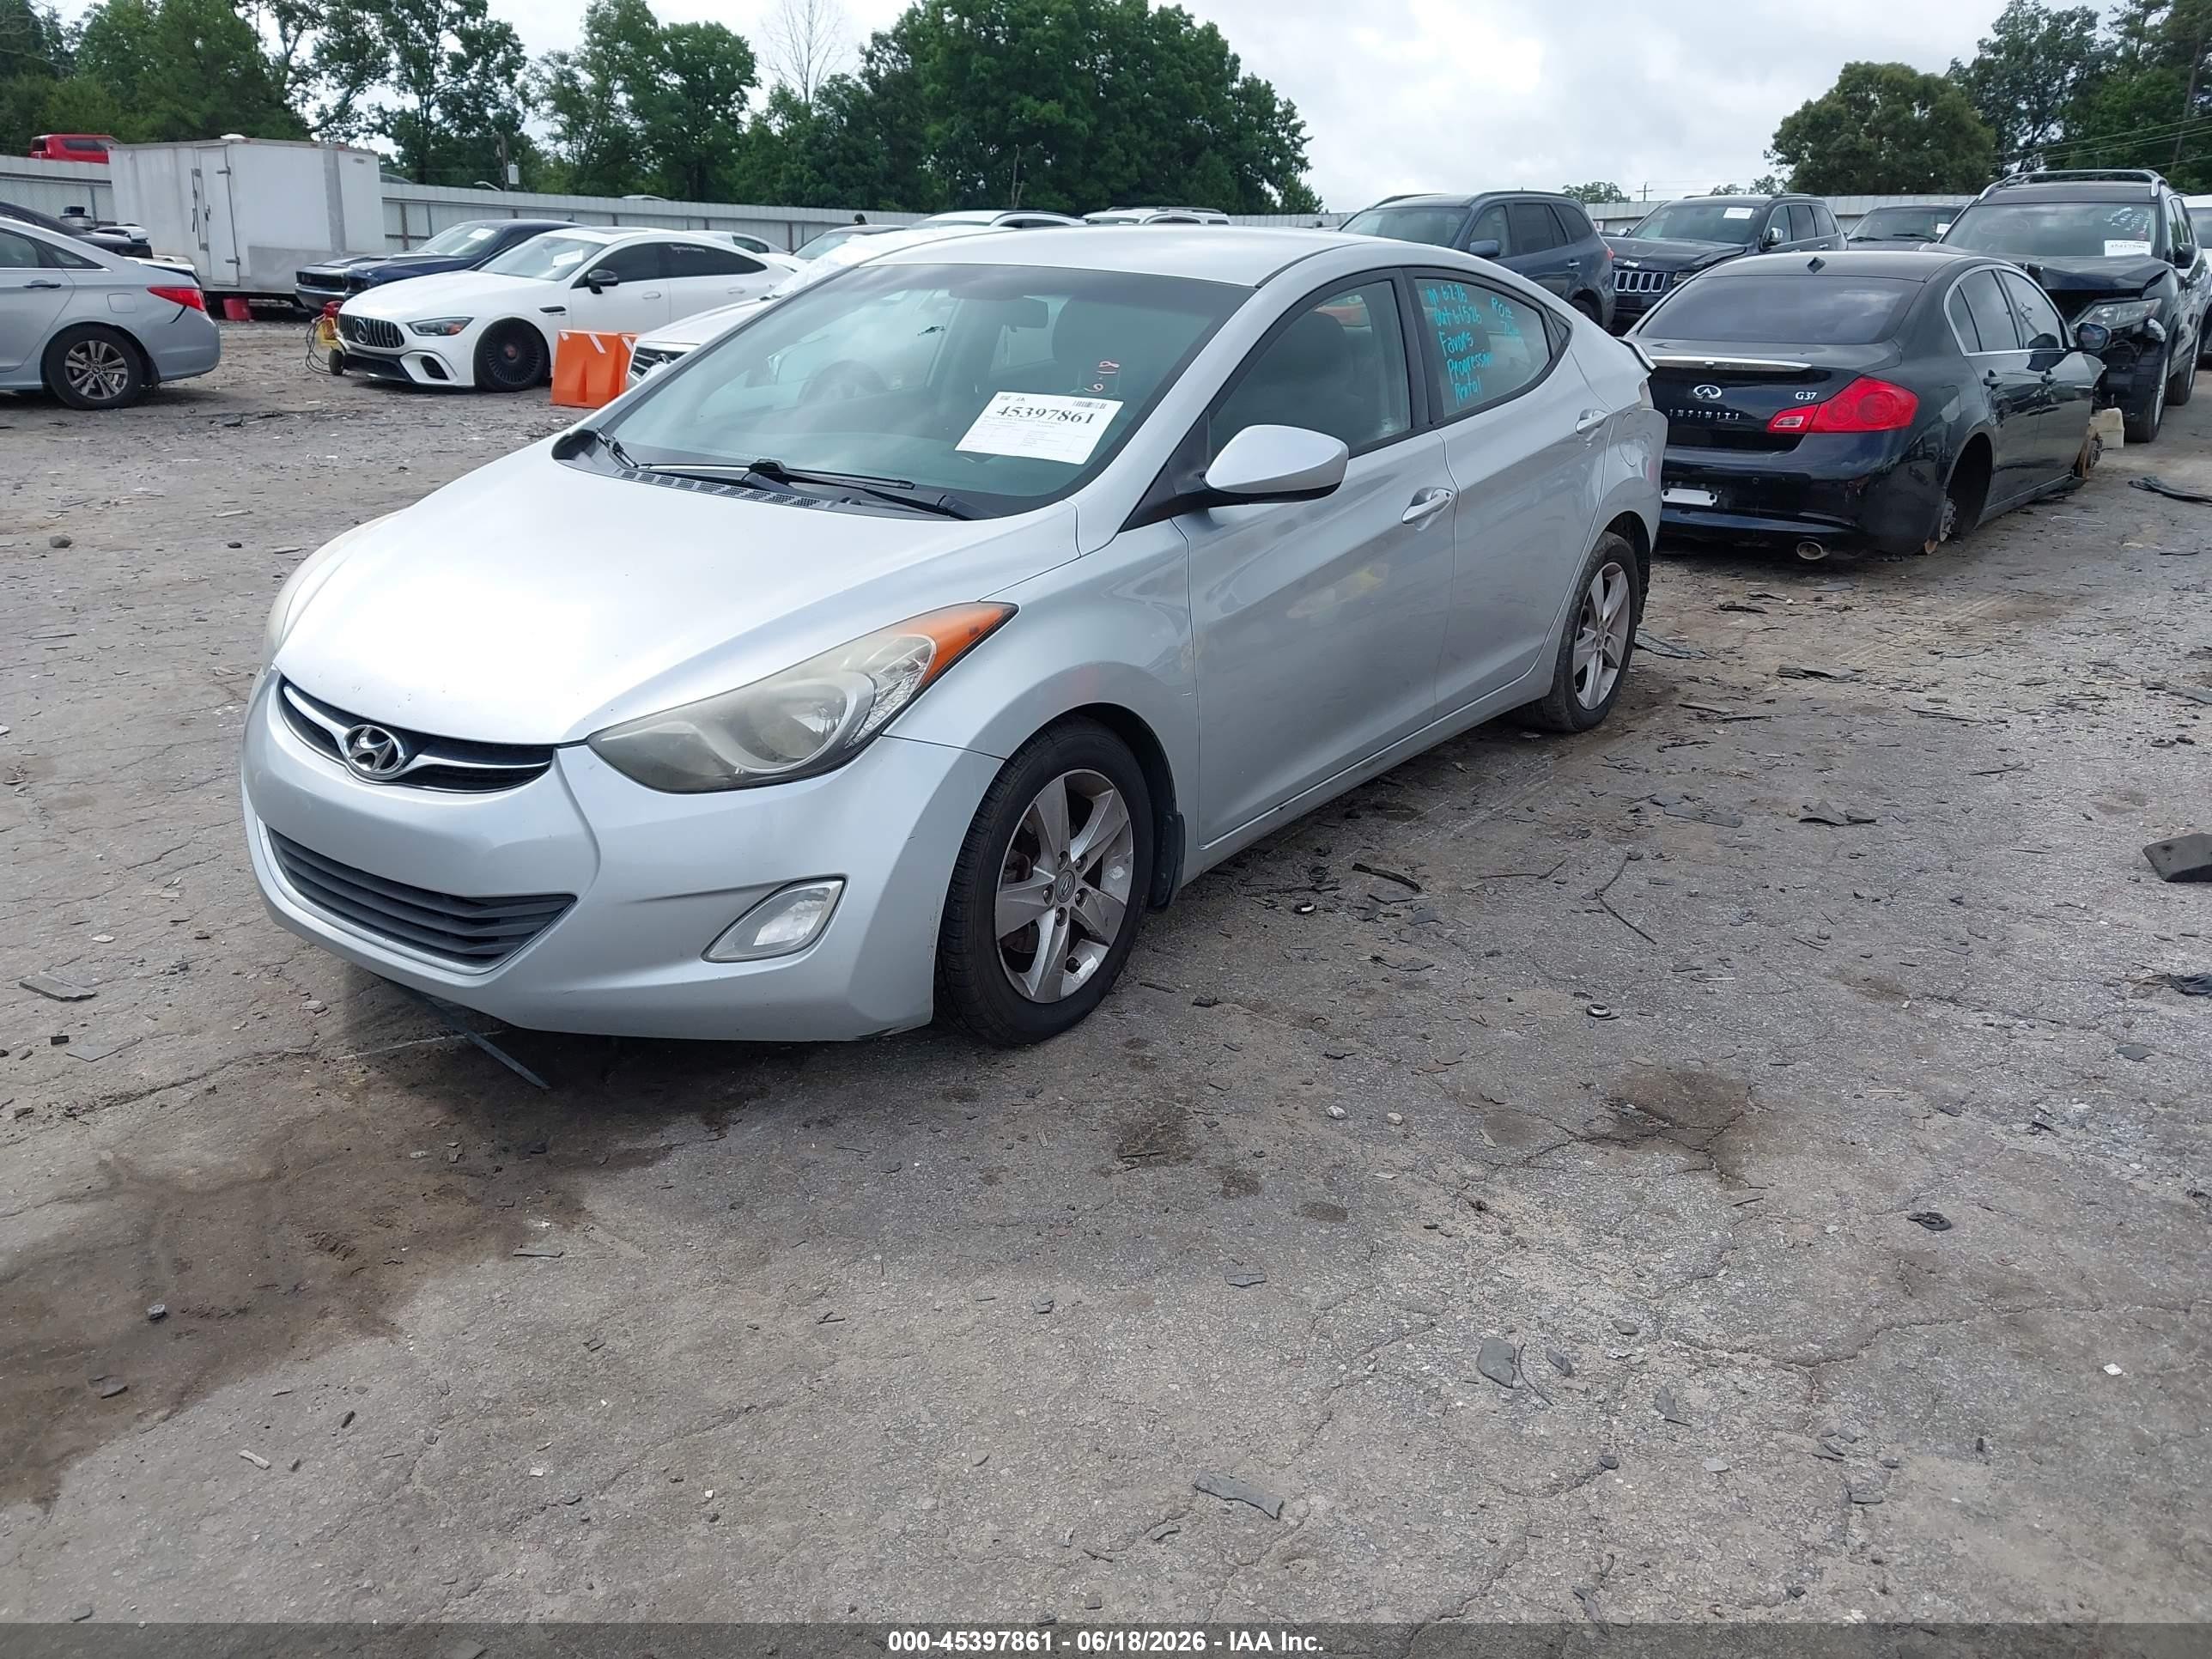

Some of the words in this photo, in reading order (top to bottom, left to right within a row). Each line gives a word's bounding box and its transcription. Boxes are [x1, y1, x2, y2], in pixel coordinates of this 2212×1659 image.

[1438, 331, 1474, 356] Favors
[1795, 391, 1818, 400] G37
[996, 405, 1095, 424] 45397861
[1669, 409, 1740, 420] INFINITI
